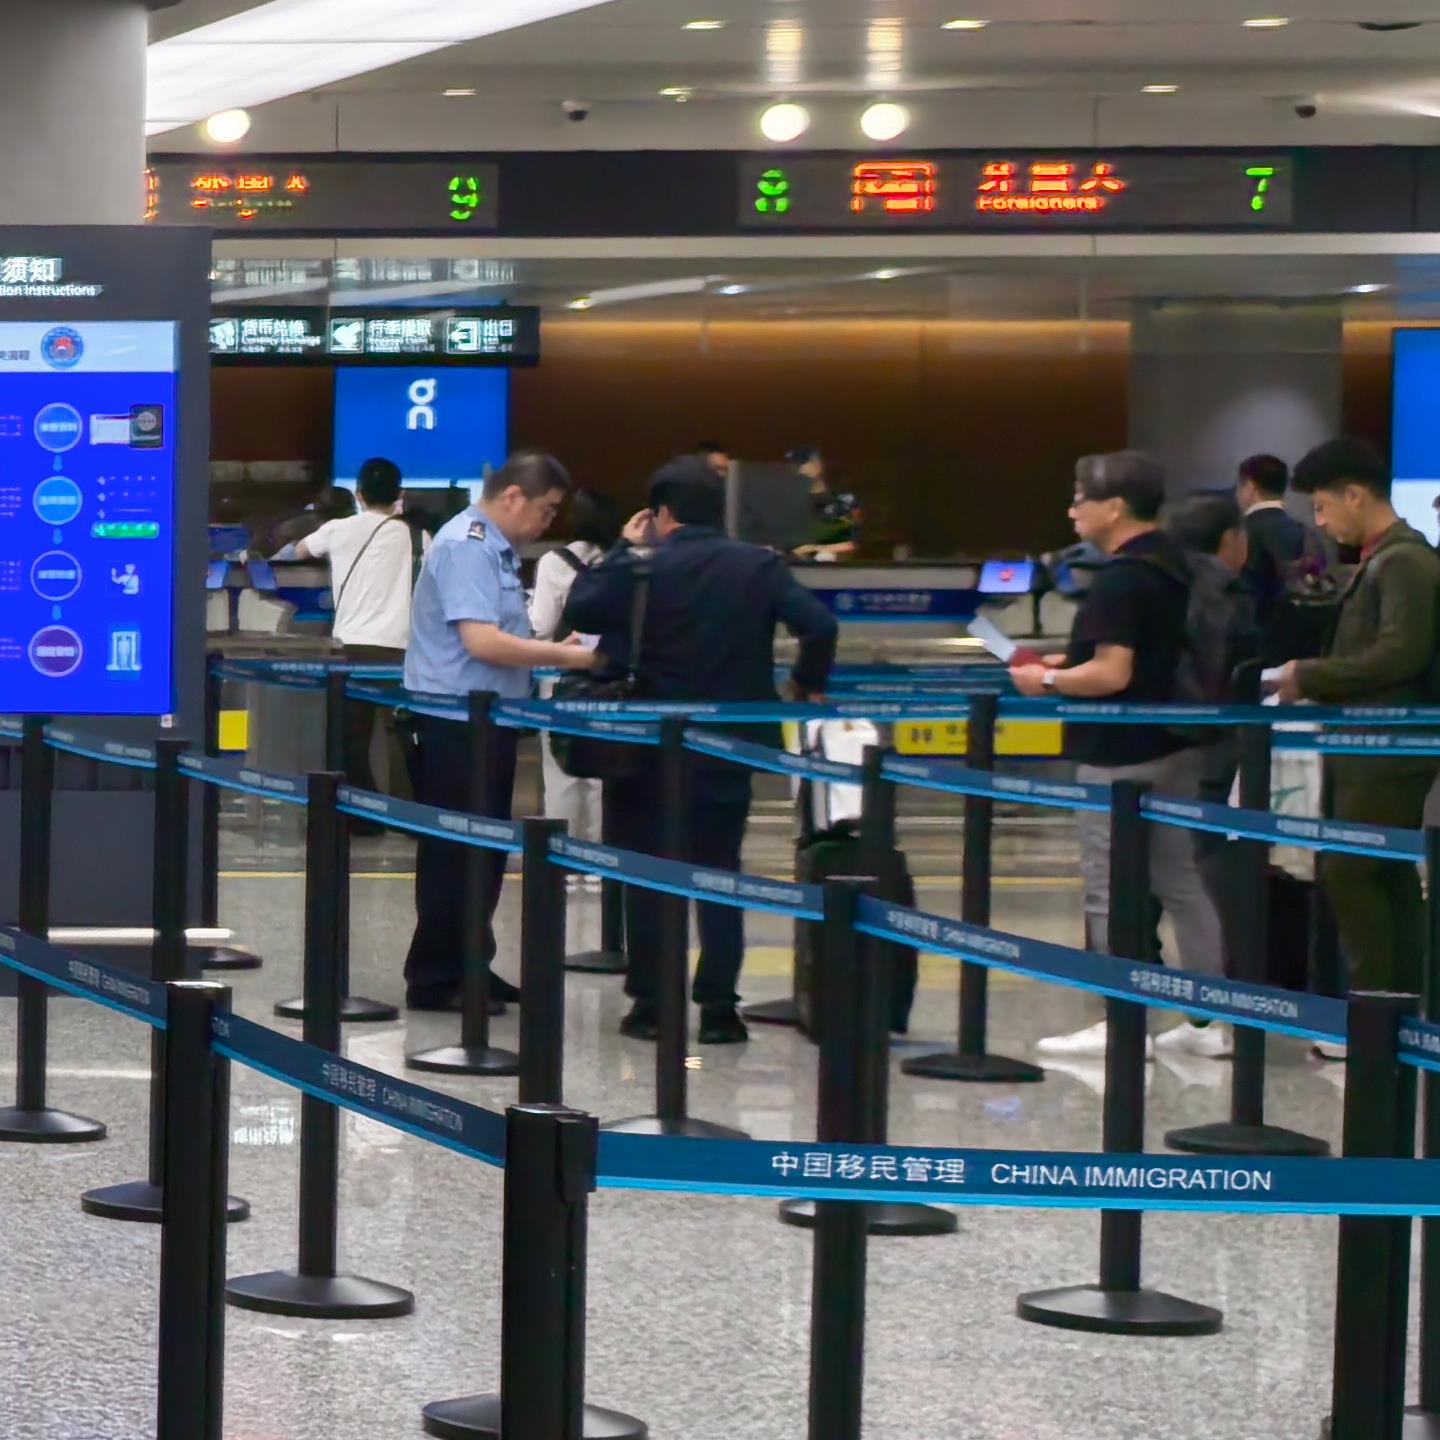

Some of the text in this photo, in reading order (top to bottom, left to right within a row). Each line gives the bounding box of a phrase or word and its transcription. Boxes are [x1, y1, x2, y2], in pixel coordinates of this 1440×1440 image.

[1246, 167, 1274, 212] 7
[772, 1153, 1271, 1189] 中国移民管理 CHINA IMMIGRATION
